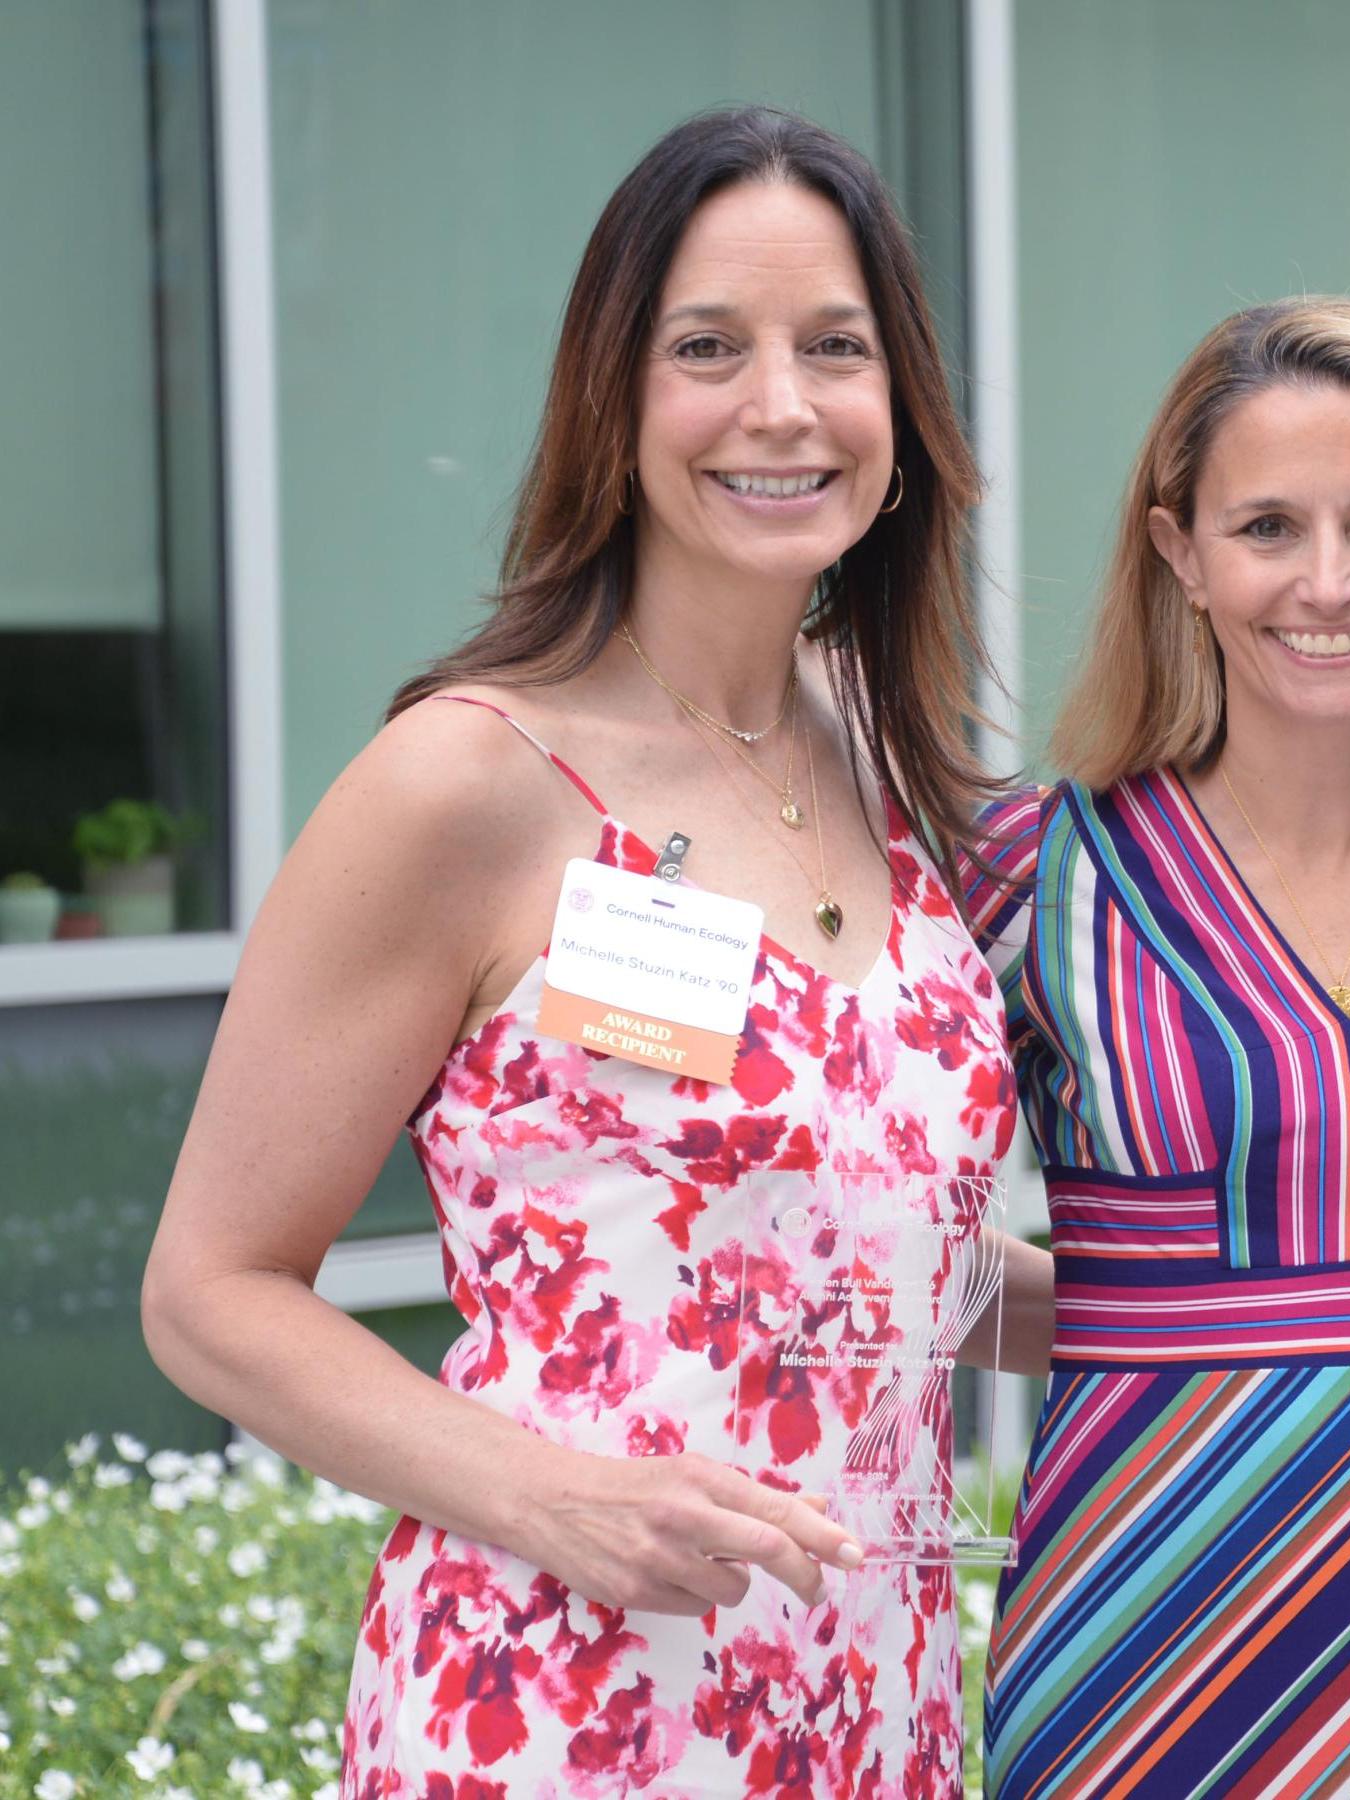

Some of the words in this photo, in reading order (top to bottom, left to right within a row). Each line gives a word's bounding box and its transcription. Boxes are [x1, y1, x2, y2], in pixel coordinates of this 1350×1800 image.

[606, 903, 651, 923] Cornell
[654, 913, 696, 935] Human
[700, 928, 749, 950] Ecology
[561, 938, 624, 965] Michelle
[628, 957, 674, 978] Stuzin
[679, 971, 711, 988] Katz
[715, 978, 738, 994] '90
[582, 1024, 687, 1064] RECIPIENT
[602, 1012, 672, 1041] AWARD
[779, 1353, 844, 1368] Michelle
